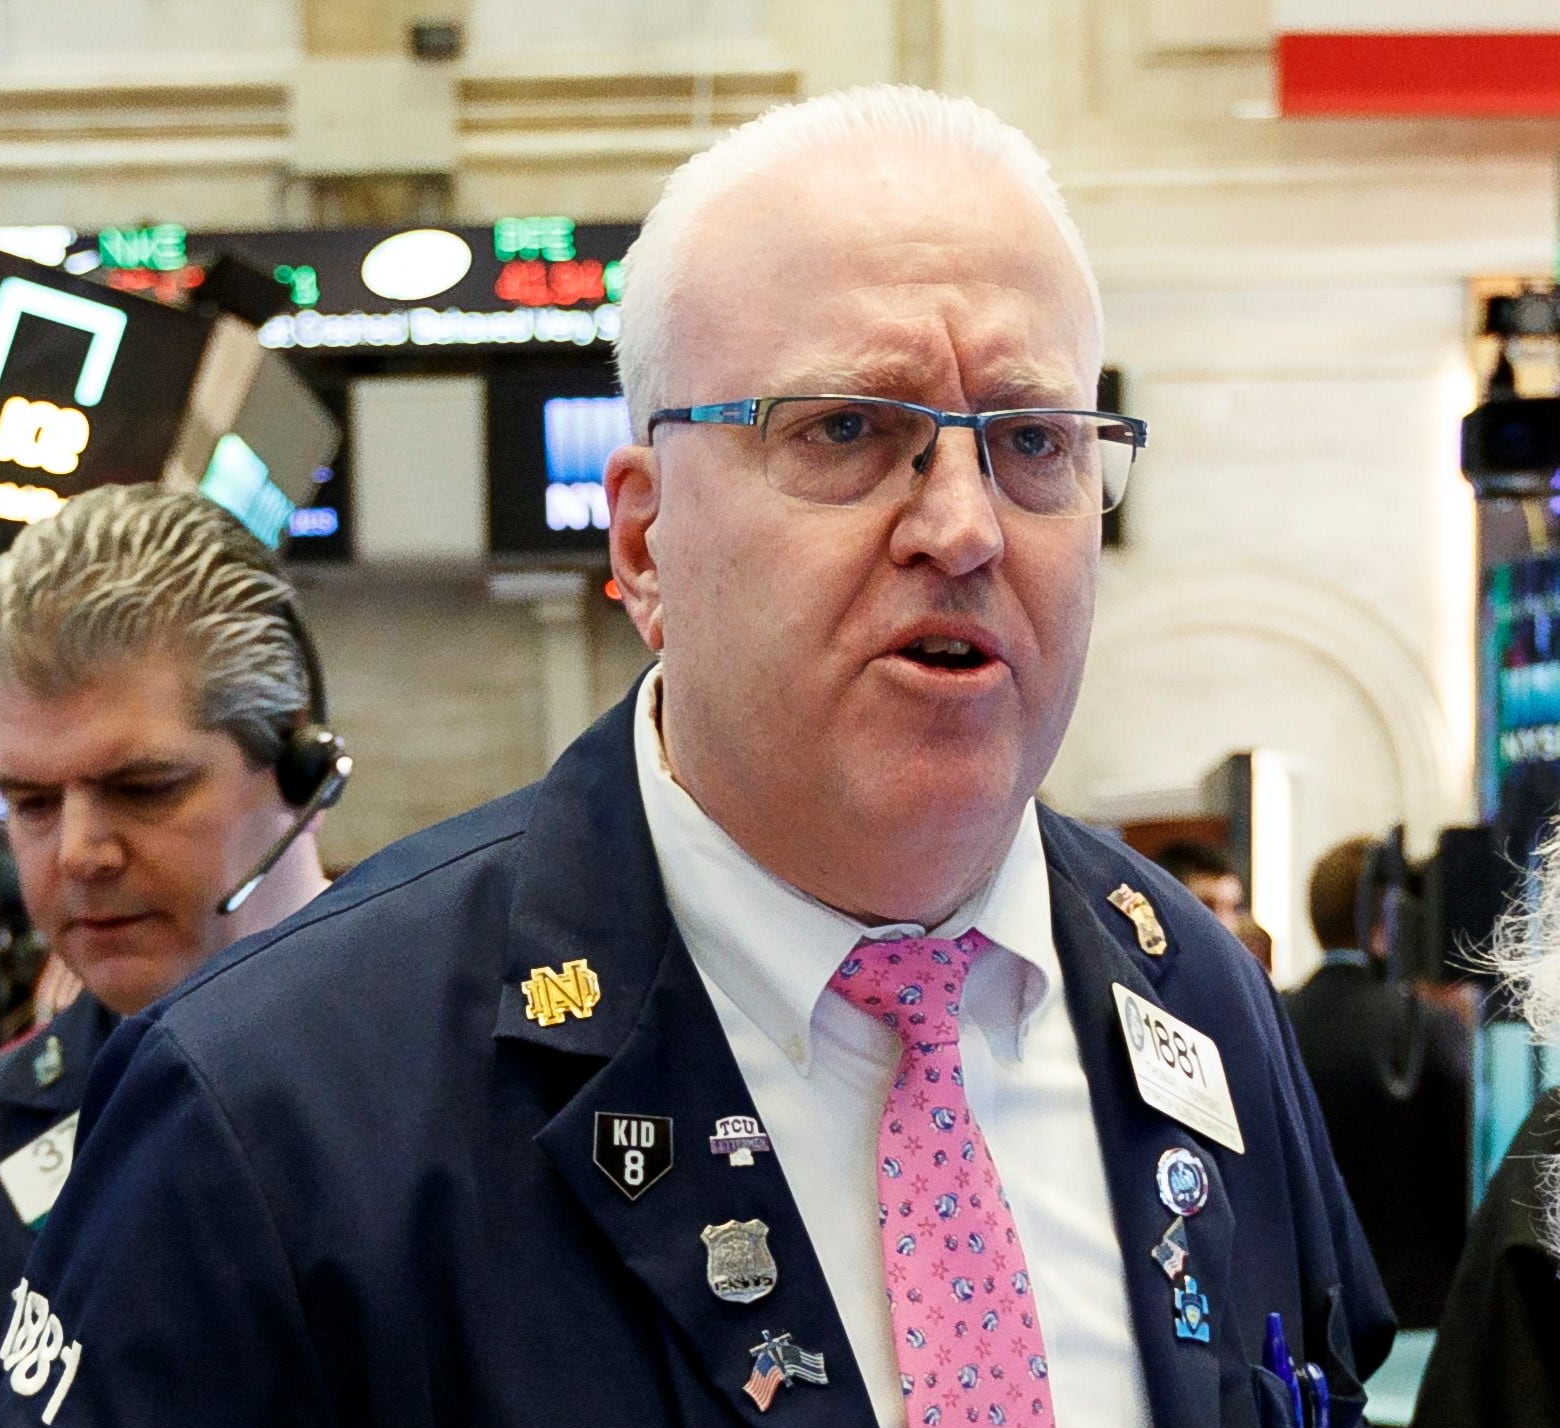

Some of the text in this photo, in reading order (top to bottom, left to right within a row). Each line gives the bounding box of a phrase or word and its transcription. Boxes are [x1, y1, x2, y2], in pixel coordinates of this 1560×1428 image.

[1144, 1012, 1206, 1087] 1881
[613, 1118, 655, 1148] KID
[719, 1118, 755, 1136] TCU
[623, 1150, 645, 1186] 8
